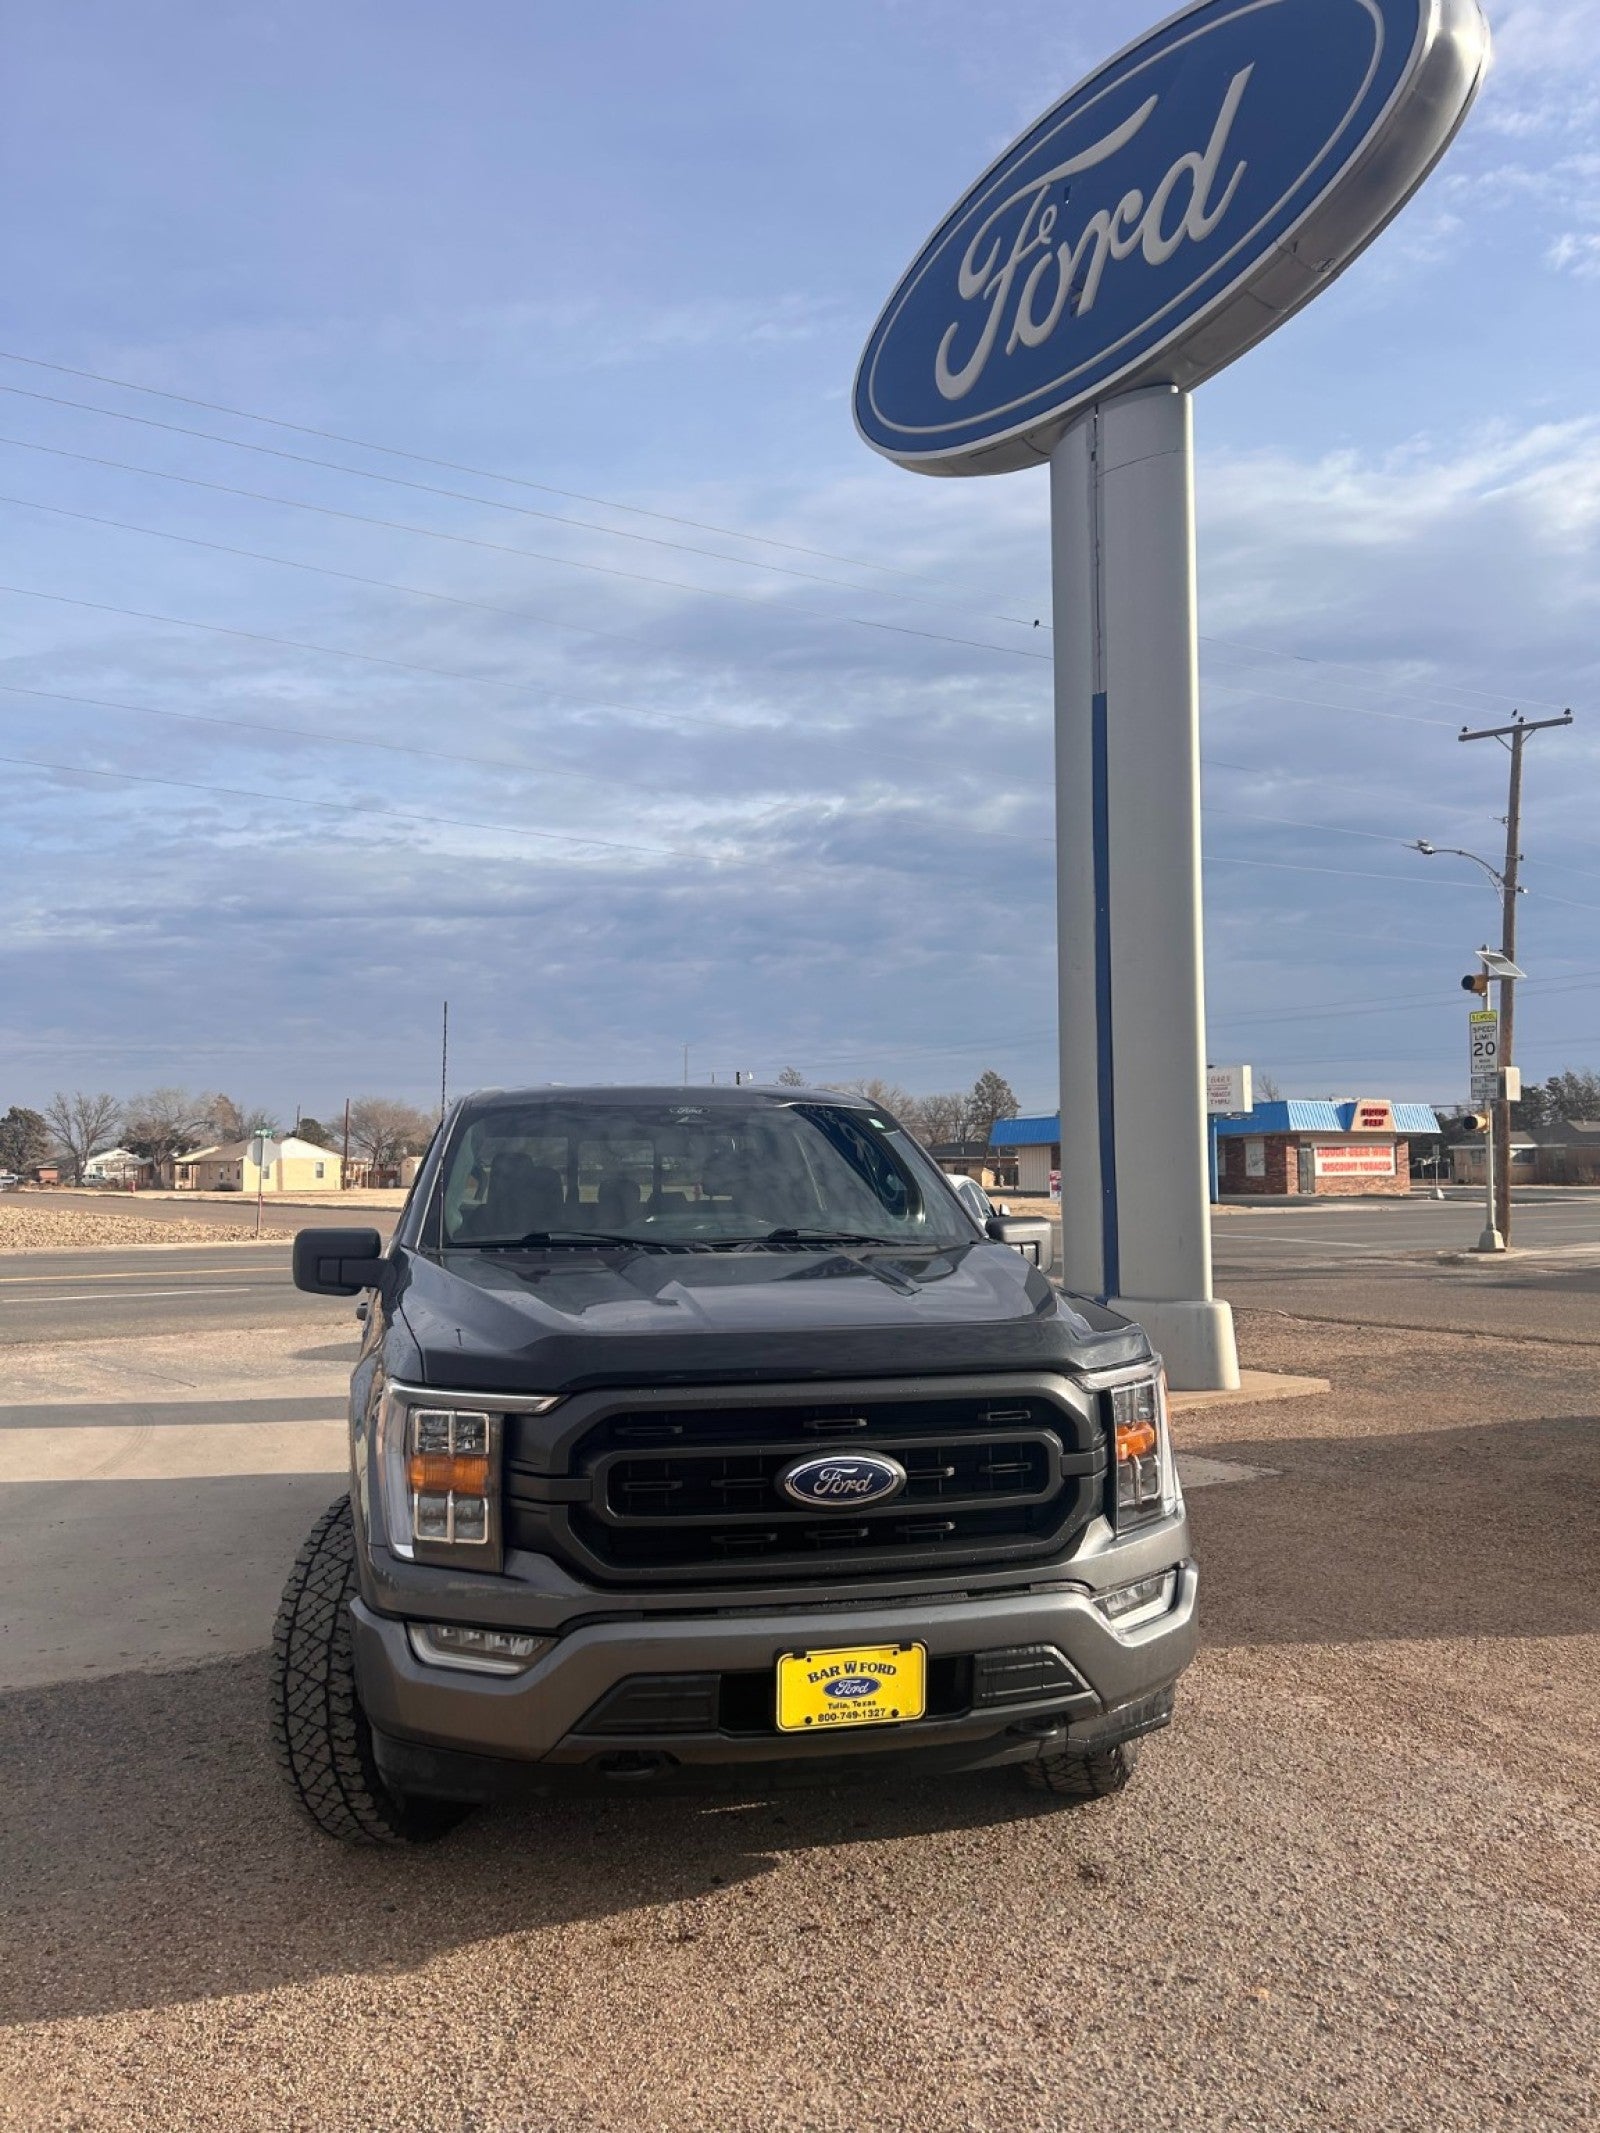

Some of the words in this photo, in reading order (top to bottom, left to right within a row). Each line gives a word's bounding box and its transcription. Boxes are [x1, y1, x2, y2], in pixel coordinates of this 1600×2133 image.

[935, 61, 1255, 400] Ford
[1472, 1025, 1496, 1033] SPEED
[1474, 1033, 1494, 1041] LIMIT
[1473, 1041, 1496, 1056] 20
[813, 1467, 873, 1495] Ford
[807, 1665, 841, 1684] BAR
[844, 1660, 857, 1674] W
[860, 1661, 897, 1676] FORD
[834, 1679, 869, 1695] Ford
[852, 1700, 876, 1708] Texas
